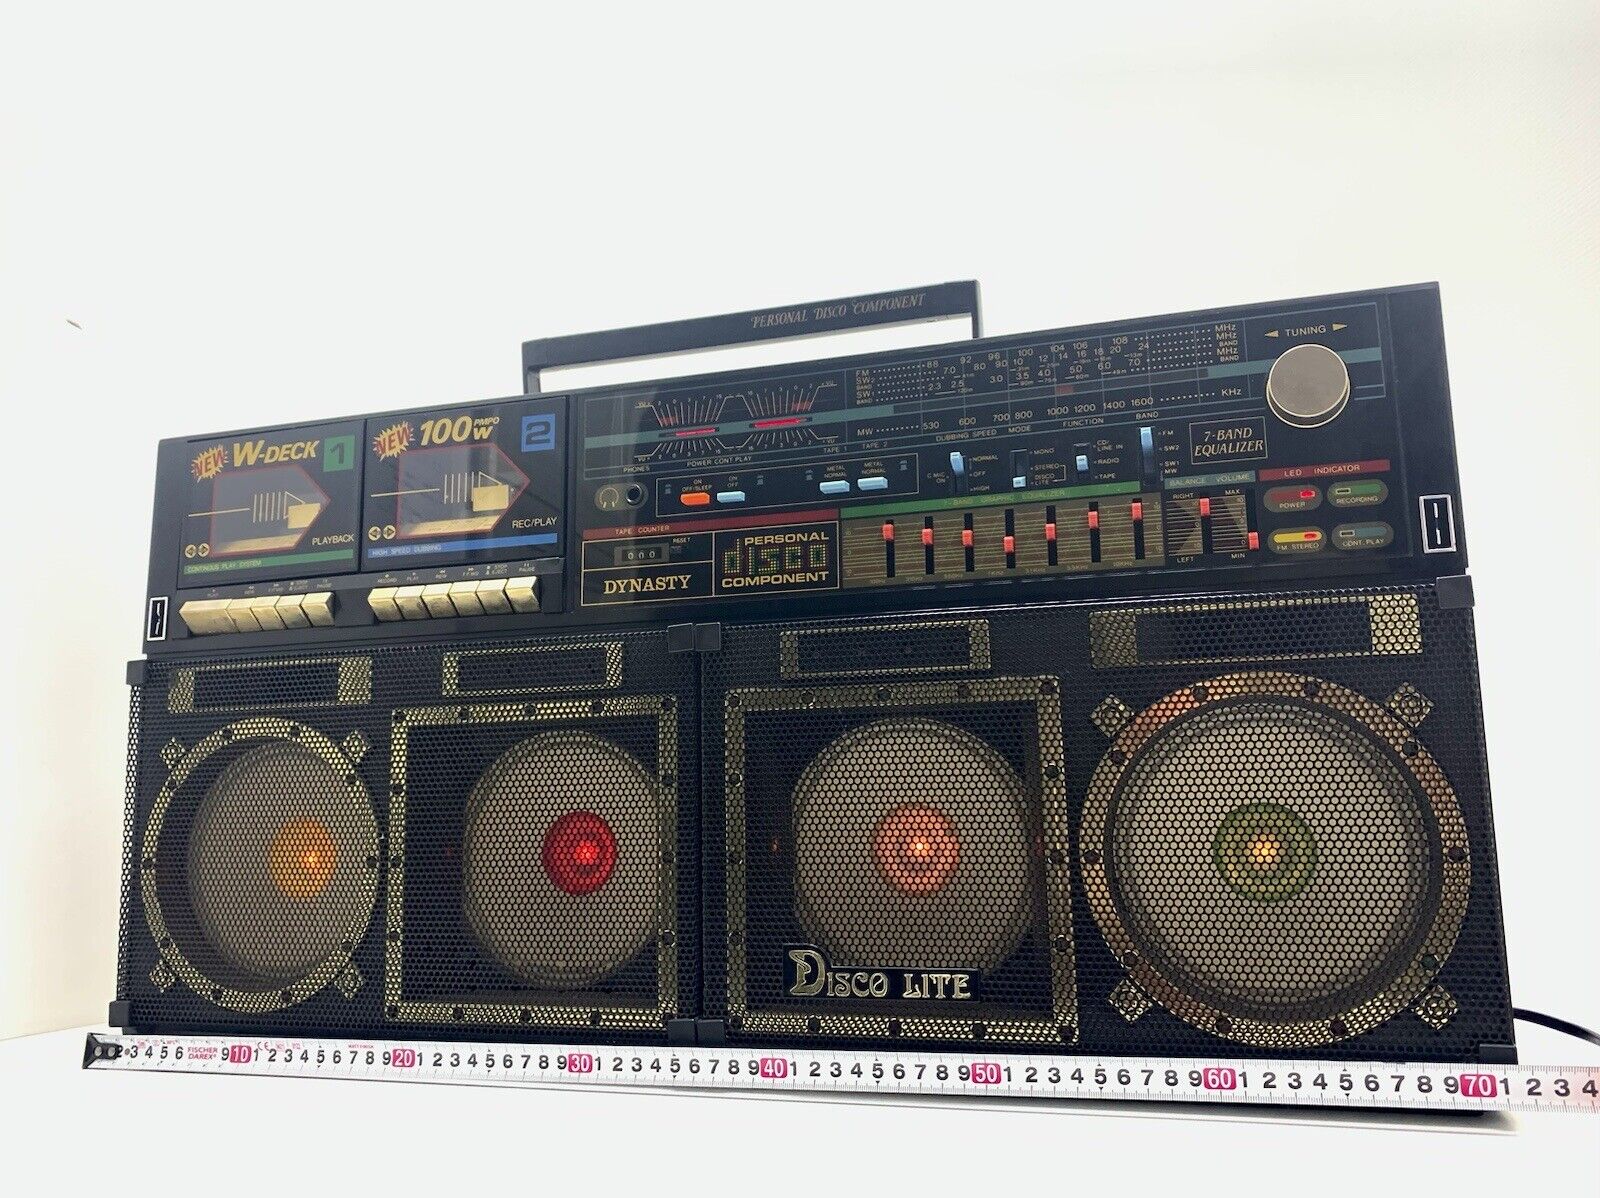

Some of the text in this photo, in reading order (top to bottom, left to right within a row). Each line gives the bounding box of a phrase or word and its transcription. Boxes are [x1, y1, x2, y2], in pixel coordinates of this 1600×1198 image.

[751, 293, 926, 329] PERSONAL DISCO COMPONENT
[1214, 323, 1237, 332] MHz
[1285, 324, 1327, 338] TUNING
[1111, 336, 1128, 345] 108
[1216, 332, 1238, 341] MHz
[1049, 344, 1066, 353] 104
[1109, 345, 1121, 354] 20
[1138, 341, 1150, 351] 24
[1018, 348, 1034, 357] 100
[1058, 352, 1068, 360] 14
[1076, 350, 1087, 358] 16
[1216, 348, 1239, 356] MHz
[960, 356, 972, 365] 92
[1013, 358, 1024, 366] 10
[1220, 387, 1242, 397] KHz
[1102, 400, 1126, 411] 1400
[1131, 396, 1154, 407] 1600
[1046, 405, 1069, 416] 1000
[1073, 403, 1096, 414] 1200
[474, 416, 501, 426] PMPO
[958, 416, 976, 426] 600
[993, 412, 1011, 422] 700
[1136, 412, 1159, 420] BAND
[923, 421, 940, 431] 530
[1063, 418, 1104, 427] FUNCTION
[420, 415, 473, 447] 100
[525, 421, 552, 446] 2
[857, 428, 874, 437] MW
[1008, 425, 1032, 433] MODE
[1203, 427, 1253, 441] 7-BAND
[376, 425, 412, 455] NEW
[936, 429, 998, 443] DUBBING SPEED
[862, 442, 880, 450] TAPE
[1034, 447, 1055, 455] MONO
[1163, 444, 1180, 452] SW2
[1194, 439, 1265, 457] EQUALIZER
[233, 440, 320, 467] W-DECK
[329, 442, 345, 465] 1
[687, 459, 712, 467] POWER
[714, 455, 752, 465] CONT PLAY
[1097, 457, 1120, 465] RADIO
[1164, 467, 1178, 475] MW
[1284, 463, 1361, 478] LED INDICATOR
[1169, 474, 1249, 487] BALANCE VOLUME
[1172, 492, 1194, 500] RIGHT
[1336, 495, 1379, 504] RECORDING
[1279, 501, 1306, 509] POWER
[511, 517, 558, 530] REC/PLAY
[615, 524, 671, 536] TAPE COUNTER
[312, 534, 355, 546] PLAYBACK
[744, 531, 830, 547] PERSONAL
[1291, 542, 1320, 550] STEREO
[603, 575, 692, 595] DYNASTY
[721, 571, 830, 589] COMPONENT
[788, 949, 972, 999] DISCO LITE
[187, 1046, 218, 1054] FISCHER
[129, 1044, 139, 1059] 3
[144, 1045, 153, 1059] 4
[160, 1045, 168, 1060] 5
[175, 1046, 184, 1060] 6
[221, 1047, 230, 1061] 9
[233, 1046, 250, 1062] 10
[254, 1048, 259, 1062] 1
[267, 1048, 277, 1063] 2
[284, 1048, 293, 1063] 3
[300, 1049, 309, 1064] 4
[316, 1049, 325, 1064] 5
[332, 1050, 342, 1064] 6
[349, 1050, 358, 1065] 7
[365, 1050, 375, 1065] 8
[382, 1051, 392, 1066] 9
[394, 1050, 413, 1066] 20
[417, 1053, 422, 1066] 1
[432, 1052, 443, 1067] 2
[450, 1052, 461, 1068] 3
[467, 1053, 478, 1068] 4
[485, 1053, 495, 1069] 5
[502, 1054, 513, 1069] 6
[521, 1054, 531, 1069] 7
[538, 1054, 549, 1070] 8
[556, 1055, 568, 1070] 9
[570, 1055, 590, 1071] 30
[595, 1057, 600, 1070] 1
[612, 1056, 623, 1072] 2
[631, 1057, 643, 1073] 3
[650, 1058, 662, 1073] 4
[670, 1058, 681, 1074] 5
[689, 1058, 701, 1074] 6
[708, 1059, 720, 1074] 7
[728, 1059, 740, 1075] 8
[748, 1060, 760, 1076] 9
[763, 1060, 785, 1077] 40
[789, 1061, 797, 1077] 1
[809, 1061, 821, 1077] 2
[829, 1062, 842, 1078] 3
[850, 1062, 863, 1079] 4
[872, 1063, 884, 1079] 5
[893, 1063, 906, 1080] 6
[914, 1064, 927, 1080] 7
[936, 1064, 949, 1081] 8
[957, 1065, 971, 1082] 9
[975, 1064, 998, 1083] 50
[1003, 1066, 1012, 1083] 1
[1025, 1066, 1038, 1083] 2
[1048, 1067, 1061, 1084] 3
[1070, 1067, 1084, 1084] 4
[1094, 1068, 1107, 1085] 5
[1117, 1068, 1131, 1086] 6
[1140, 1069, 1154, 1086] 7
[1164, 1069, 1179, 1087] 8
[1188, 1070, 1203, 1088] 9
[1207, 1069, 1232, 1088] 60
[1238, 1071, 1248, 1088] 1
[1262, 1071, 1277, 1089] 2
[1287, 1072, 1302, 1090] 3
[1312, 1073, 1328, 1091] 4
[1339, 1073, 1353, 1091] 5
[1364, 1074, 1380, 1092] 6
[1390, 1075, 1405, 1092] 7
[1417, 1075, 1433, 1094] 8
[1443, 1076, 1459, 1094] 9
[1467, 1075, 1493, 1097] 70
[1499, 1077, 1510, 1096] 1
[1526, 1078, 1543, 1096] 2
[1553, 1078, 1571, 1097] 3
[1581, 1079, 1599, 1098] 4
